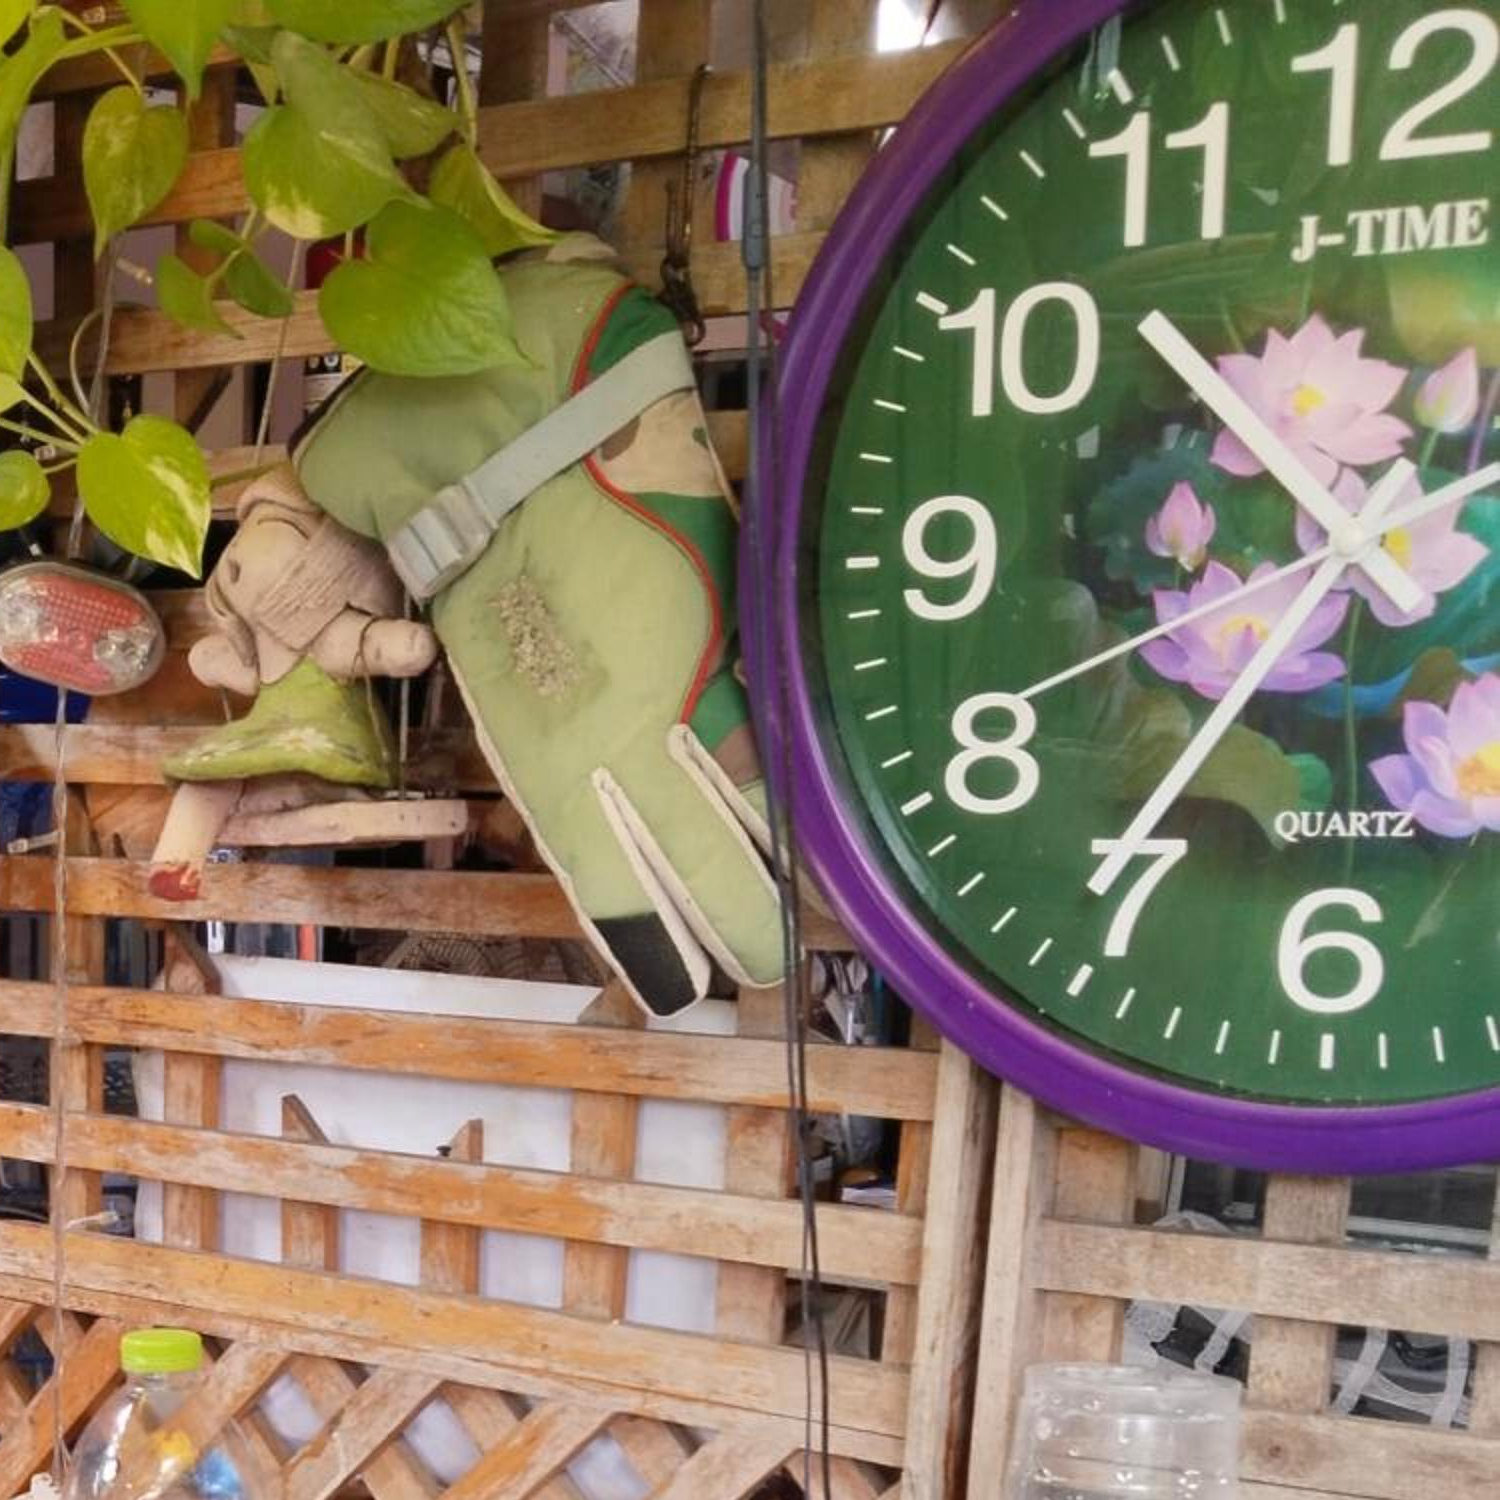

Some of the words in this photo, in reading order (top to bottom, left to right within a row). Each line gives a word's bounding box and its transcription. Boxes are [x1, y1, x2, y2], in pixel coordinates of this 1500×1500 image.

[1291, 8, 1500, 167] 12
[1088, 102, 1229, 248] 11
[1290, 198, 1490, 263] J-TIME
[938, 281, 1100, 417] 10
[902, 495, 998, 621] 9
[944, 691, 1041, 815] 8
[1273, 810, 1416, 843] QUARTZ
[1088, 837, 1189, 958] 7
[1276, 887, 1385, 1015] 6
